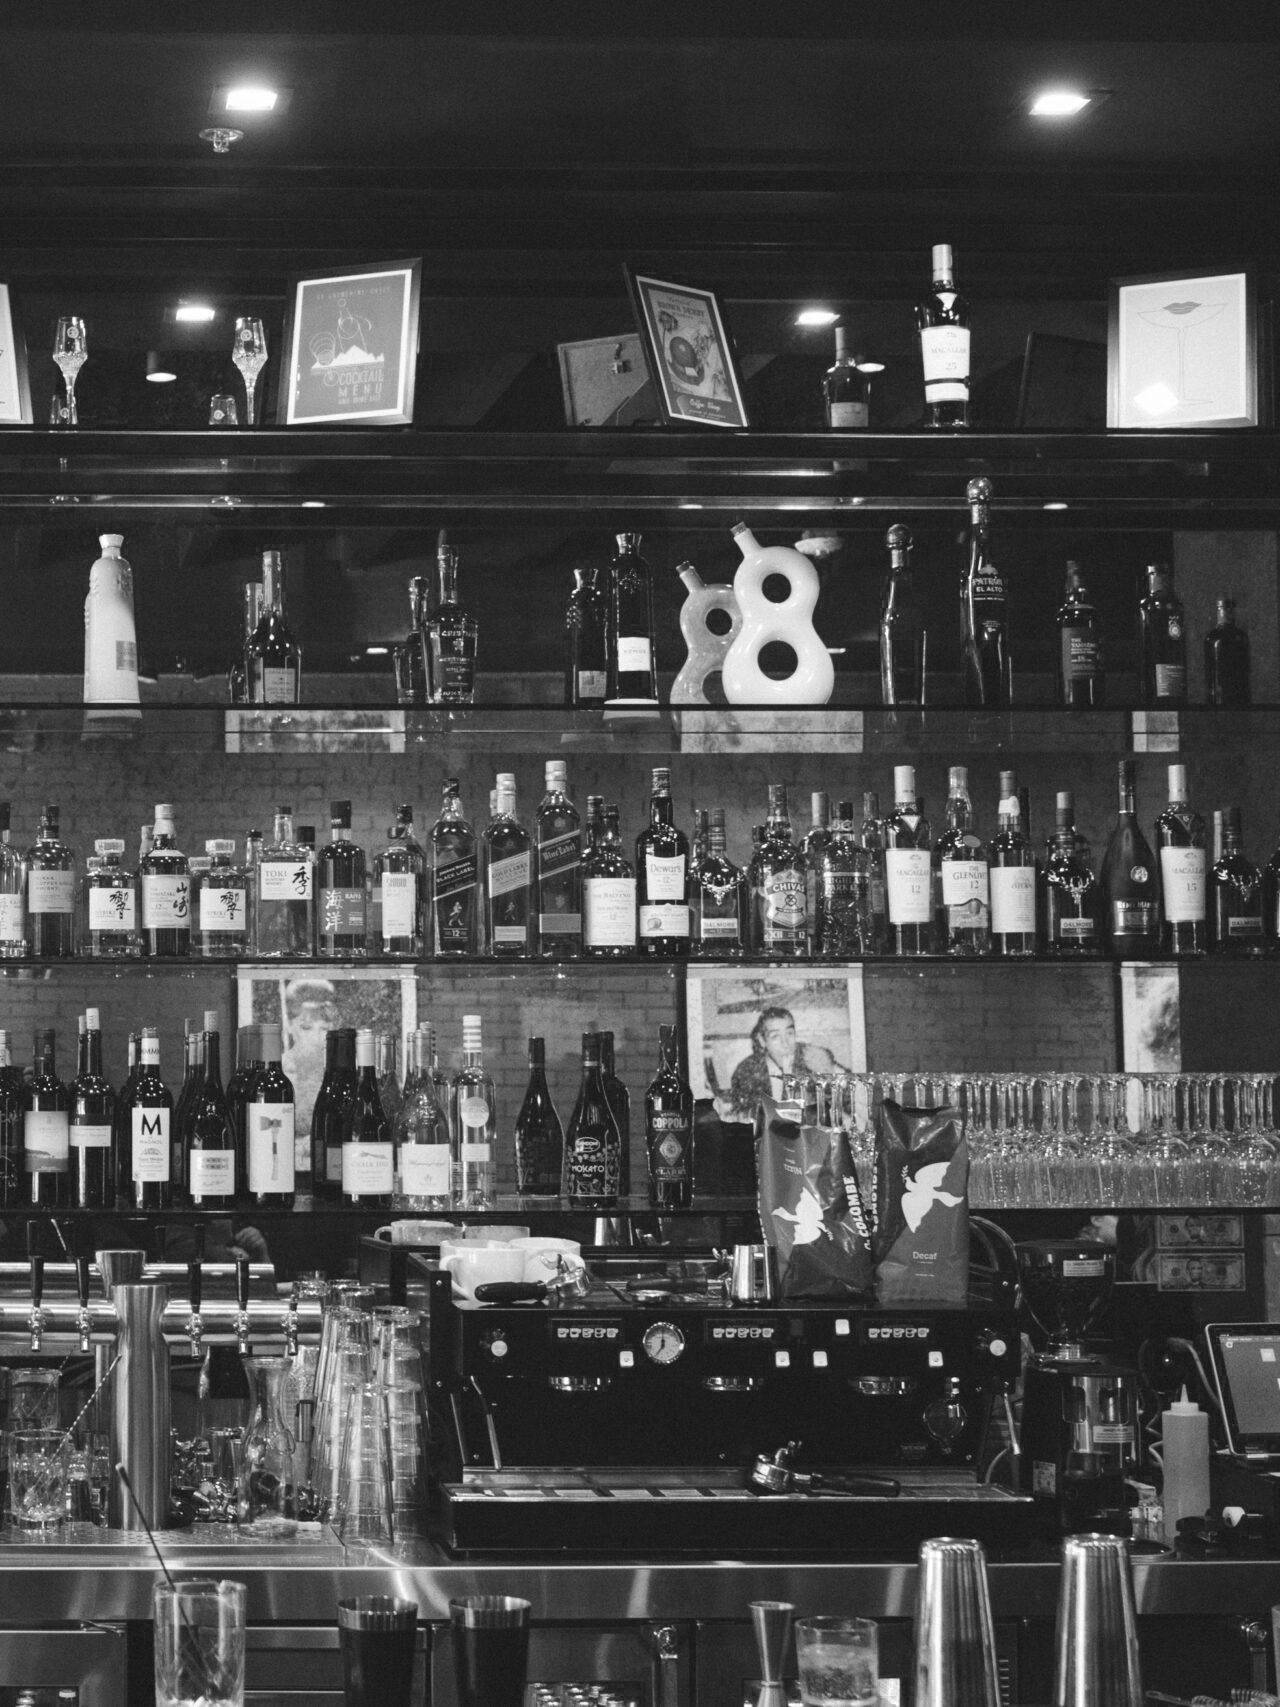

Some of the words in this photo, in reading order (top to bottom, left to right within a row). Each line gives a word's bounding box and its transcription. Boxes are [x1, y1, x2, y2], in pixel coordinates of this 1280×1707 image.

[338, 382, 383, 397] MENU
[437, 873, 455, 883] BLACK
[455, 866, 475, 877] LABEL
[911, 885, 921, 894] 12
[970, 880, 979, 889] 12
[1187, 882, 1197, 892] 15
[141, 1114, 162, 1135] M
[652, 1117, 688, 1130] COPPOLA
[842, 1175, 870, 1238] COLOMBE
[912, 1251, 937, 1260] Decaf
